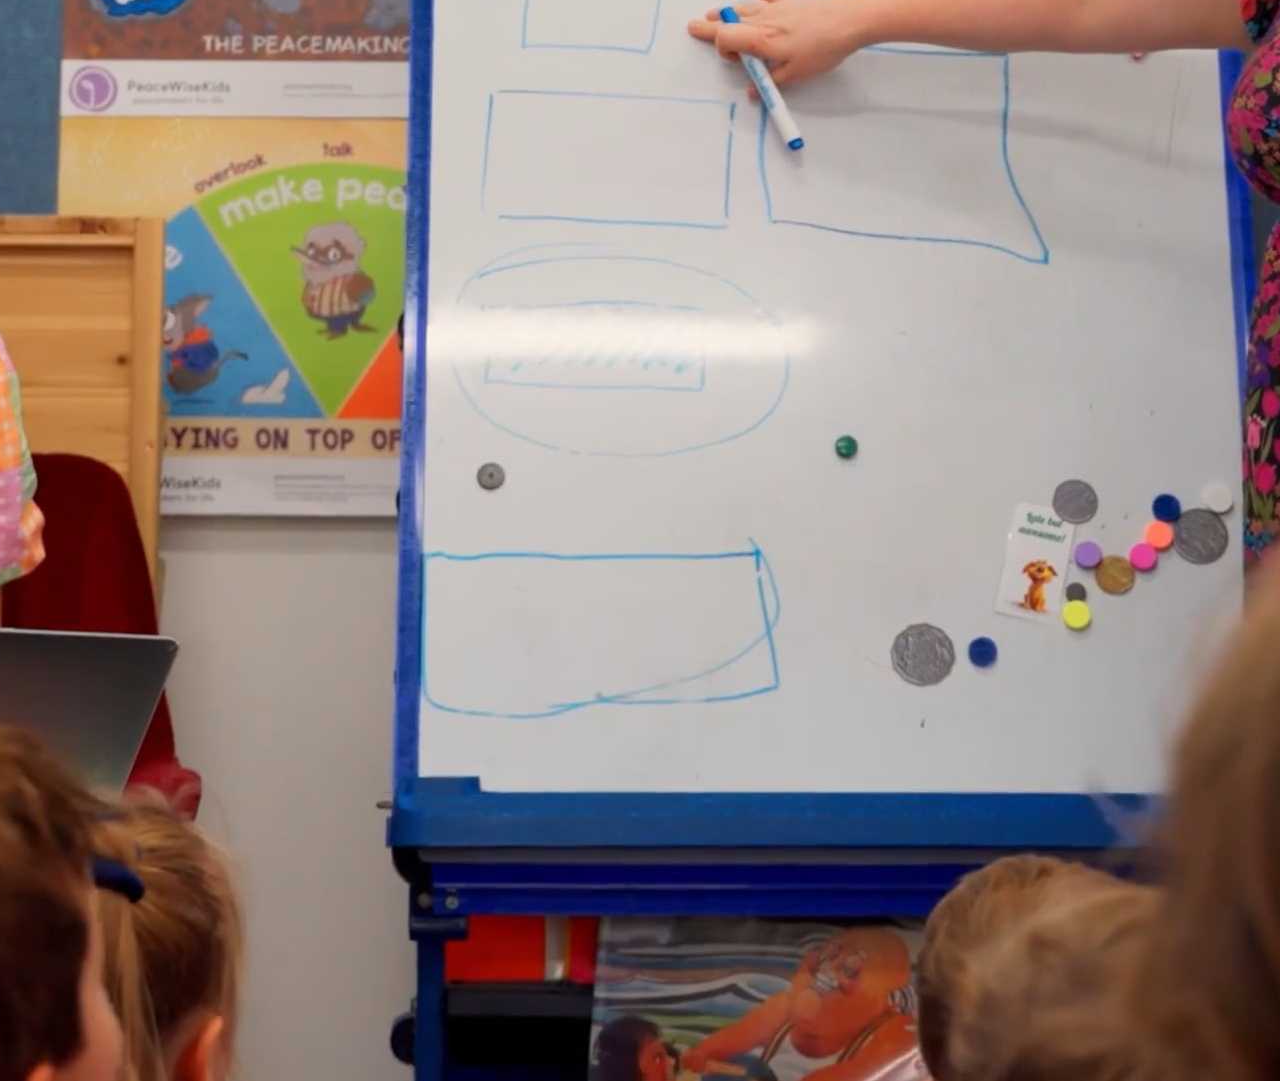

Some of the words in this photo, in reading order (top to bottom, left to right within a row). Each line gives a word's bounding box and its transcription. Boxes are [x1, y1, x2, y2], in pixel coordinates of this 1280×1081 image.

[202, 35, 244, 54] THE
[127, 80, 231, 93] PeaceWiseKids
[194, 154, 267, 193] overlook
[323, 142, 353, 157] talk
[220, 175, 323, 227] make
[164, 427, 238, 450] YING
[256, 428, 289, 450] ON
[306, 429, 354, 450] TOP
